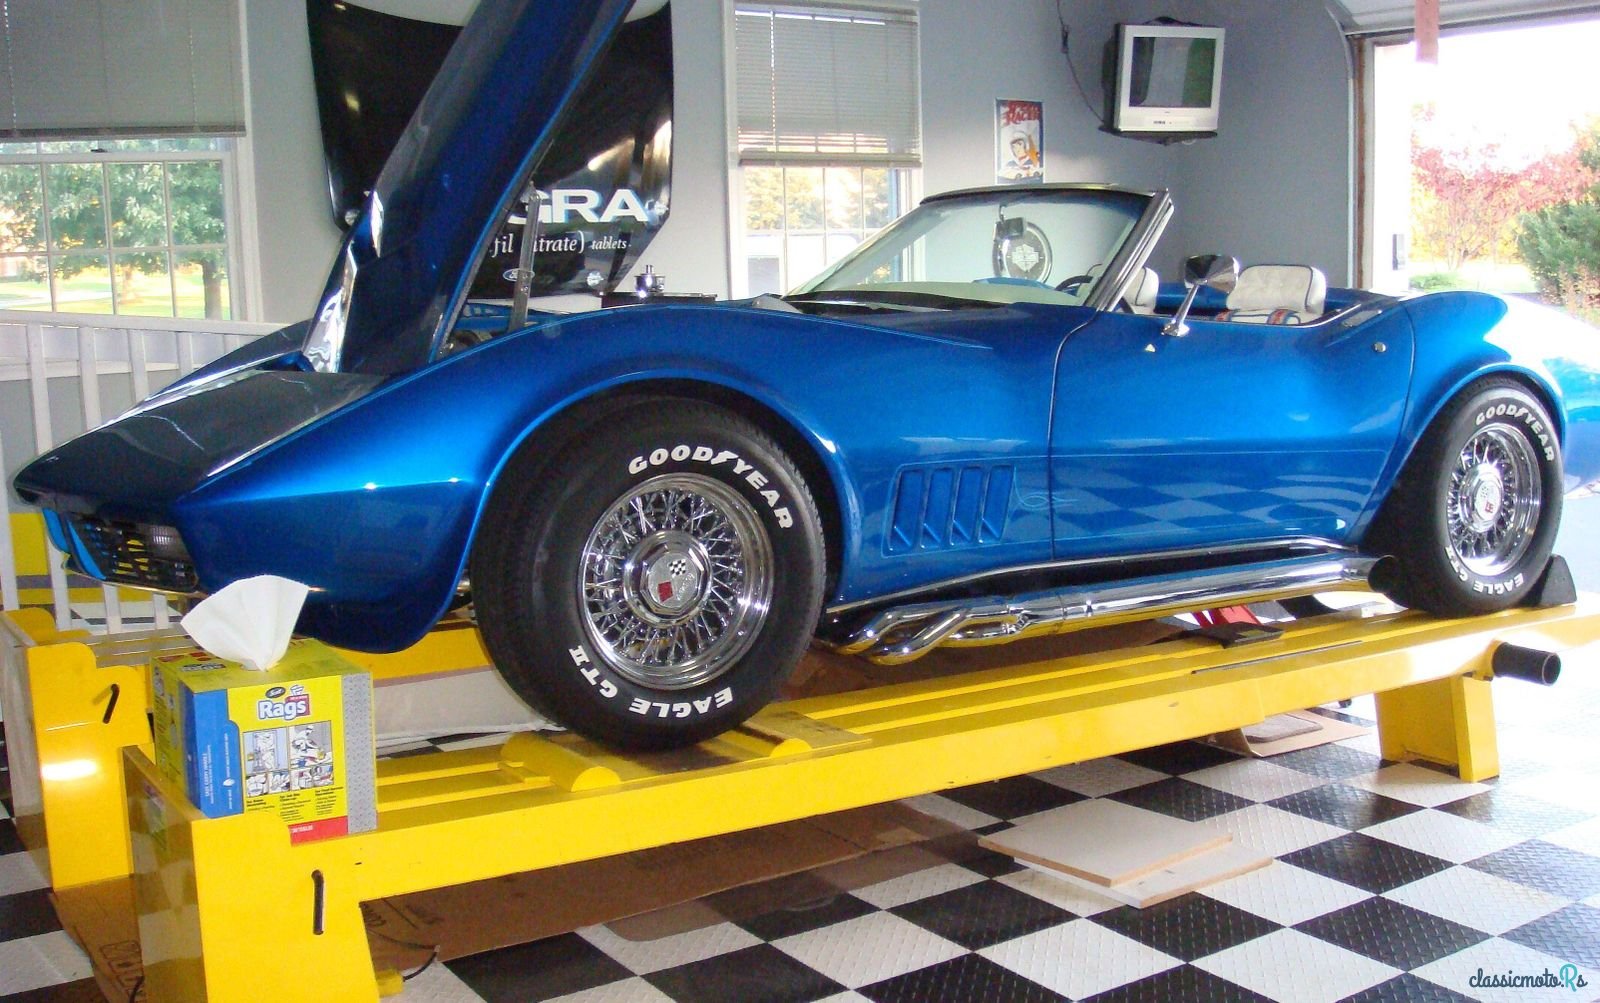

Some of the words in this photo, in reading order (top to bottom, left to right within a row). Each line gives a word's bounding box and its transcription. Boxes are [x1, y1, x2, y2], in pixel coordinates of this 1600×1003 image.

[507, 188, 649, 225] GRA
[591, 234, 627, 251] tablets
[1475, 403, 1555, 461] GOODYEAR
[628, 444, 794, 529] GOODYEAR
[1473, 572, 1524, 595] EAGLE
[258, 700, 307, 720] Rags
[628, 687, 734, 718] EAGLE
